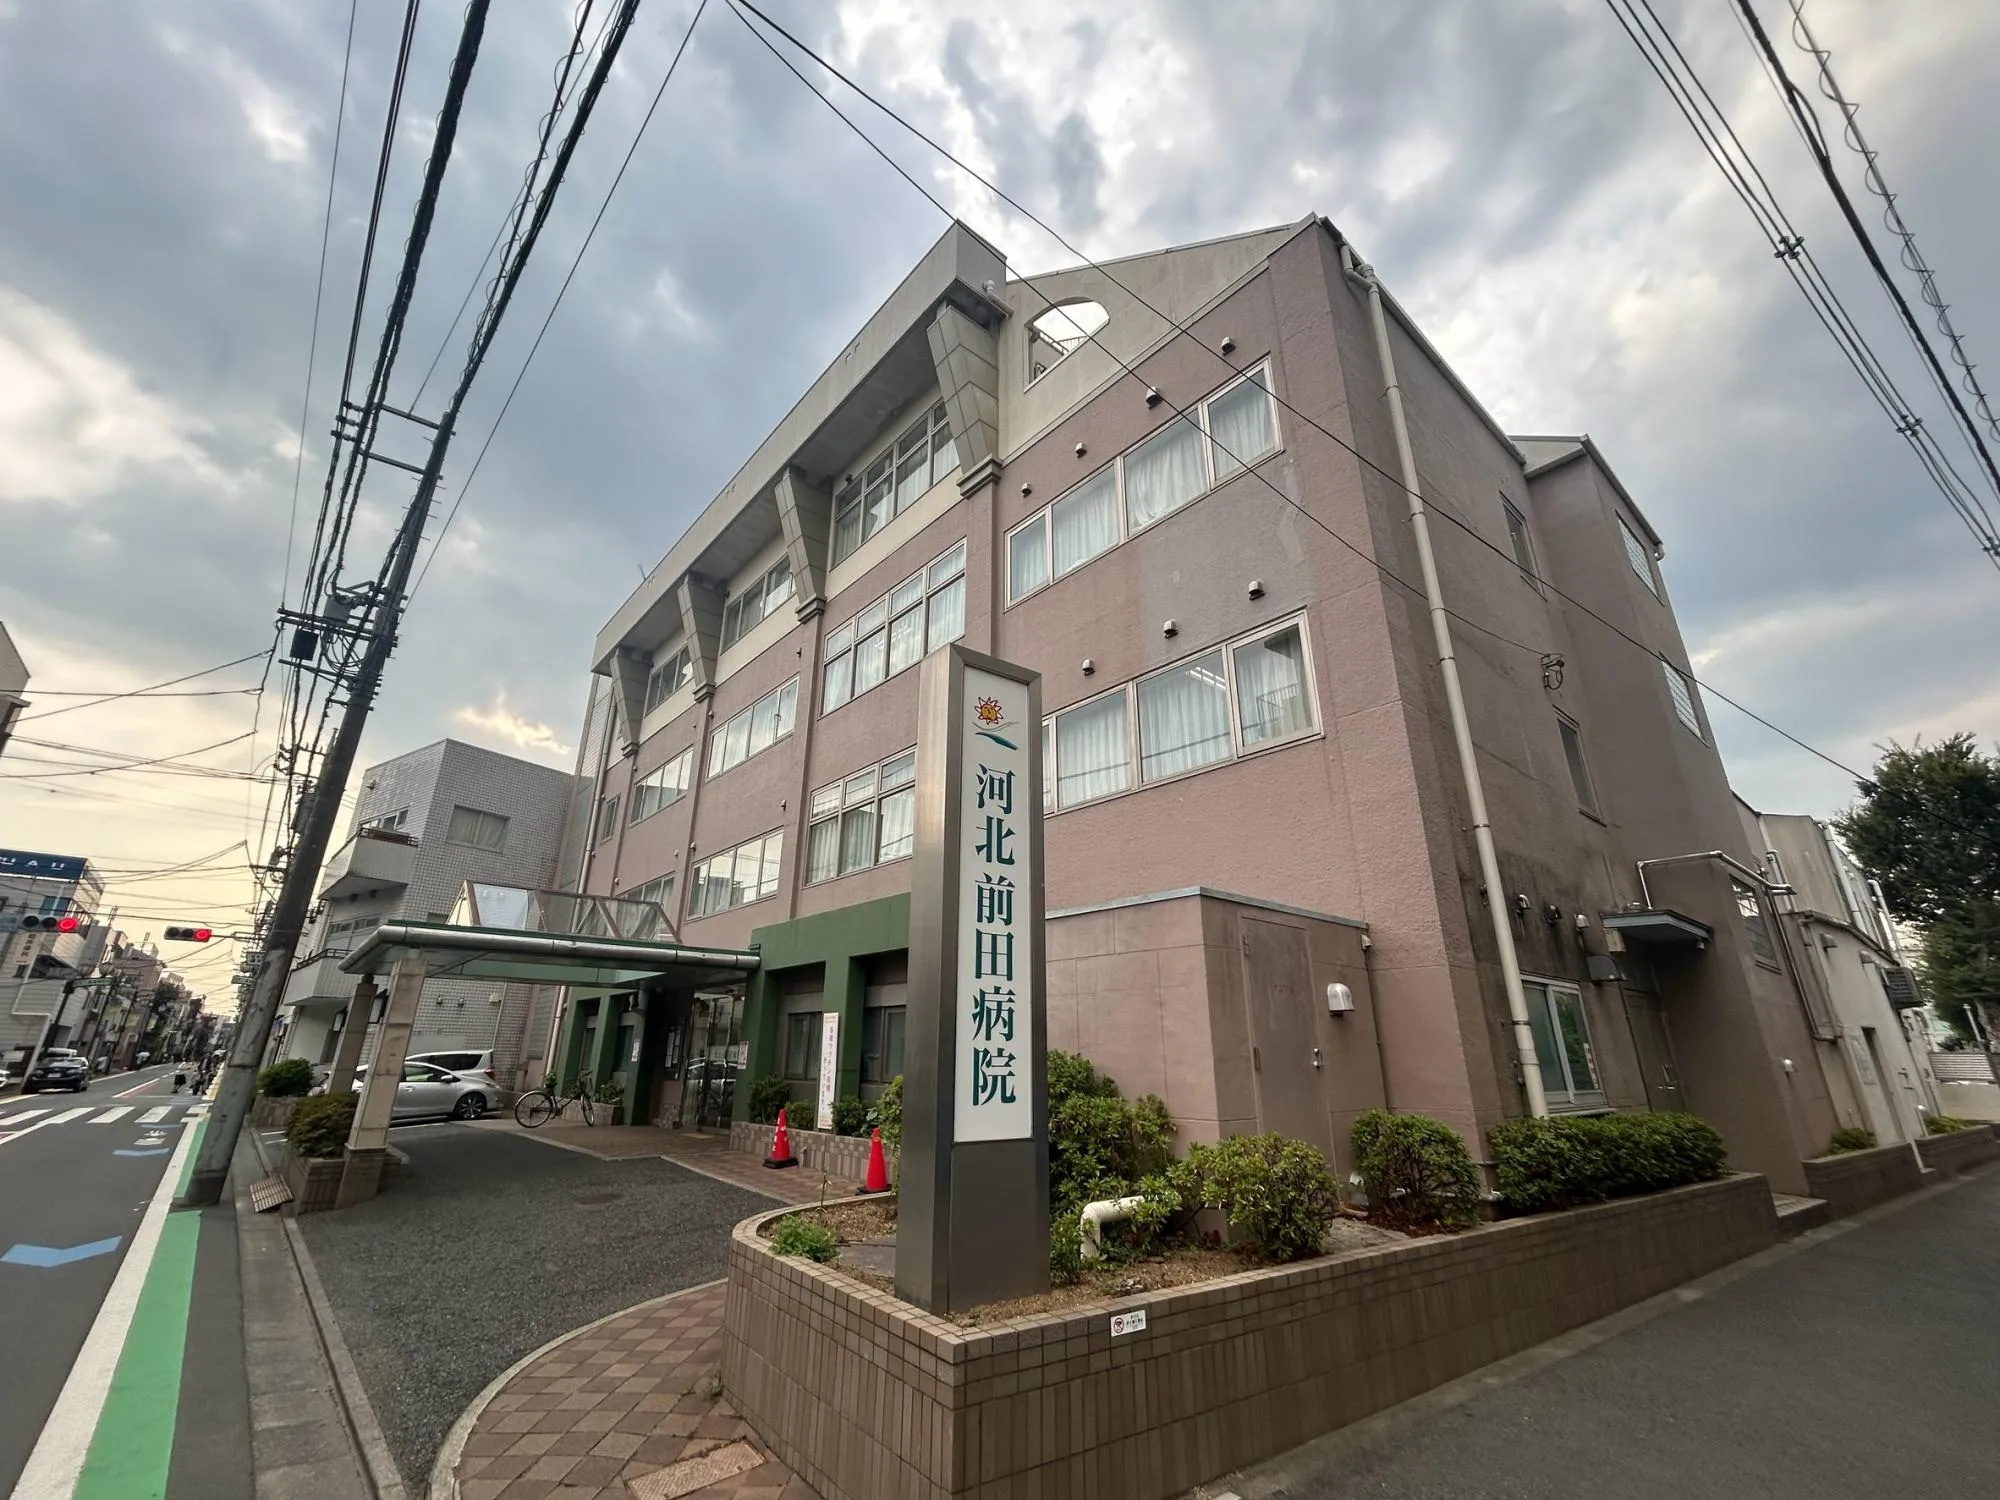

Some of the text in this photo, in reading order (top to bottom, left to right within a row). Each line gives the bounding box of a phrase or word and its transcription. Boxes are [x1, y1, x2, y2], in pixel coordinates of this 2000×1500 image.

[972, 763, 1016, 1106] 河北前田病院
